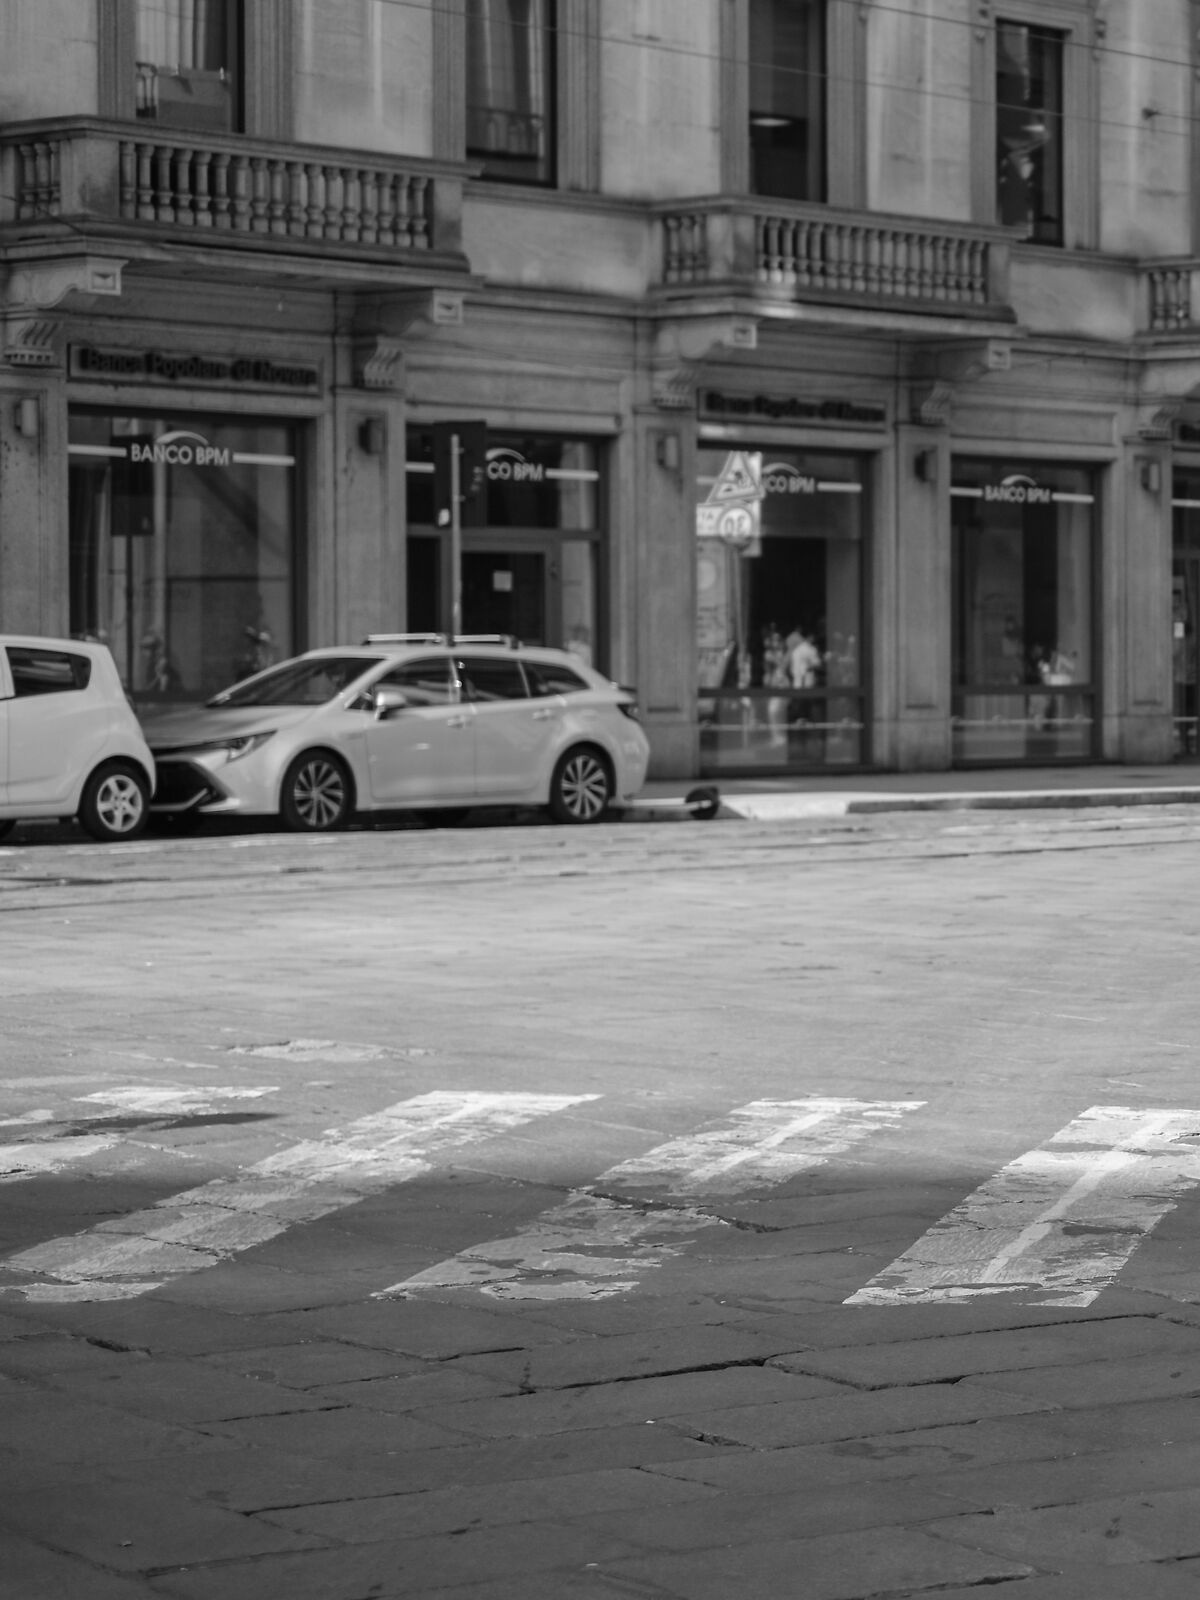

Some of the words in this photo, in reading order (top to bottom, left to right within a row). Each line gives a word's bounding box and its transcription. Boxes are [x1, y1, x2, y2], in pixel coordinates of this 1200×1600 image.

[131, 443, 193, 465] BANCO
[195, 447, 229, 467] BPM
[513, 463, 543, 482] BPM
[984, 485, 1026, 503] BANCO
